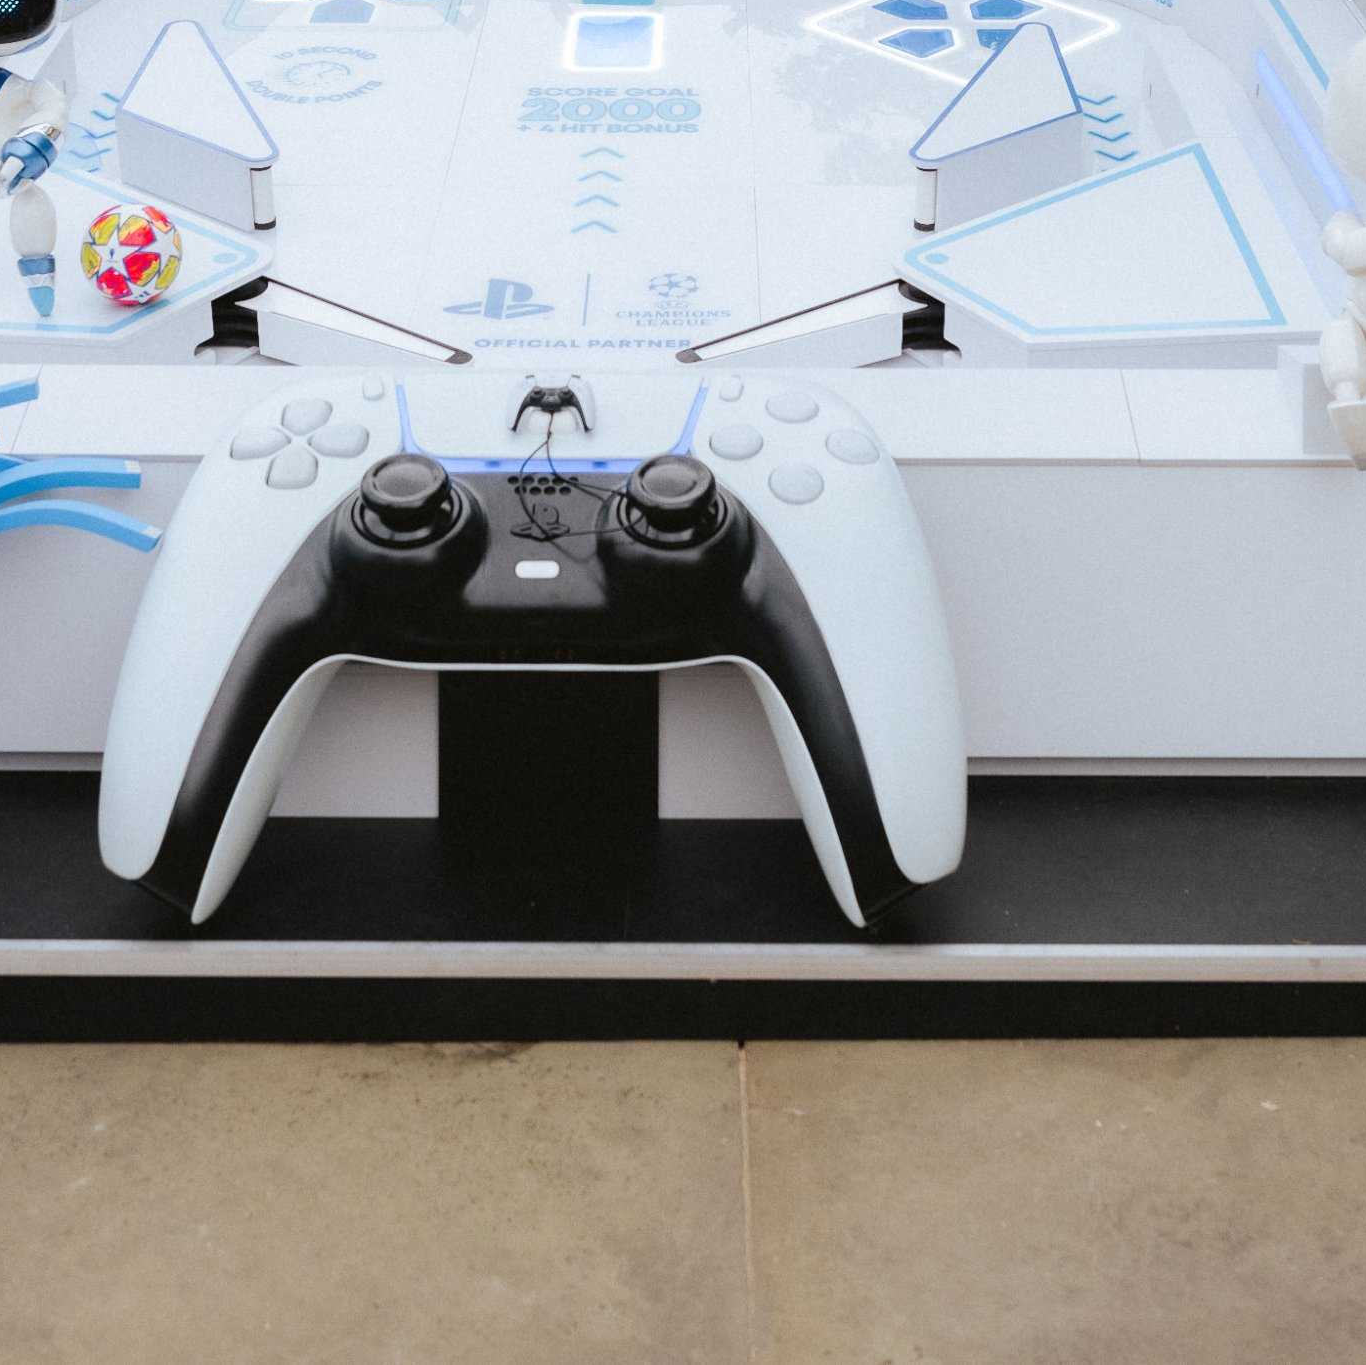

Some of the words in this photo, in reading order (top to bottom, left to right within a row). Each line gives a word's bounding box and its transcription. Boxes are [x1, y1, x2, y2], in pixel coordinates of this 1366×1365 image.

[527, 87, 618, 97] SCORE
[625, 87, 700, 97] GOAL
[517, 97, 702, 123] 2000
[539, 124, 555, 133] 4
[560, 124, 603, 133] HIT
[606, 124, 700, 133] BONUS
[616, 309, 732, 318] CHAMPIONS
[636, 319, 712, 327] LEAGUE
[474, 338, 580, 349] OFFICIAL
[588, 338, 693, 349] PARTNER
